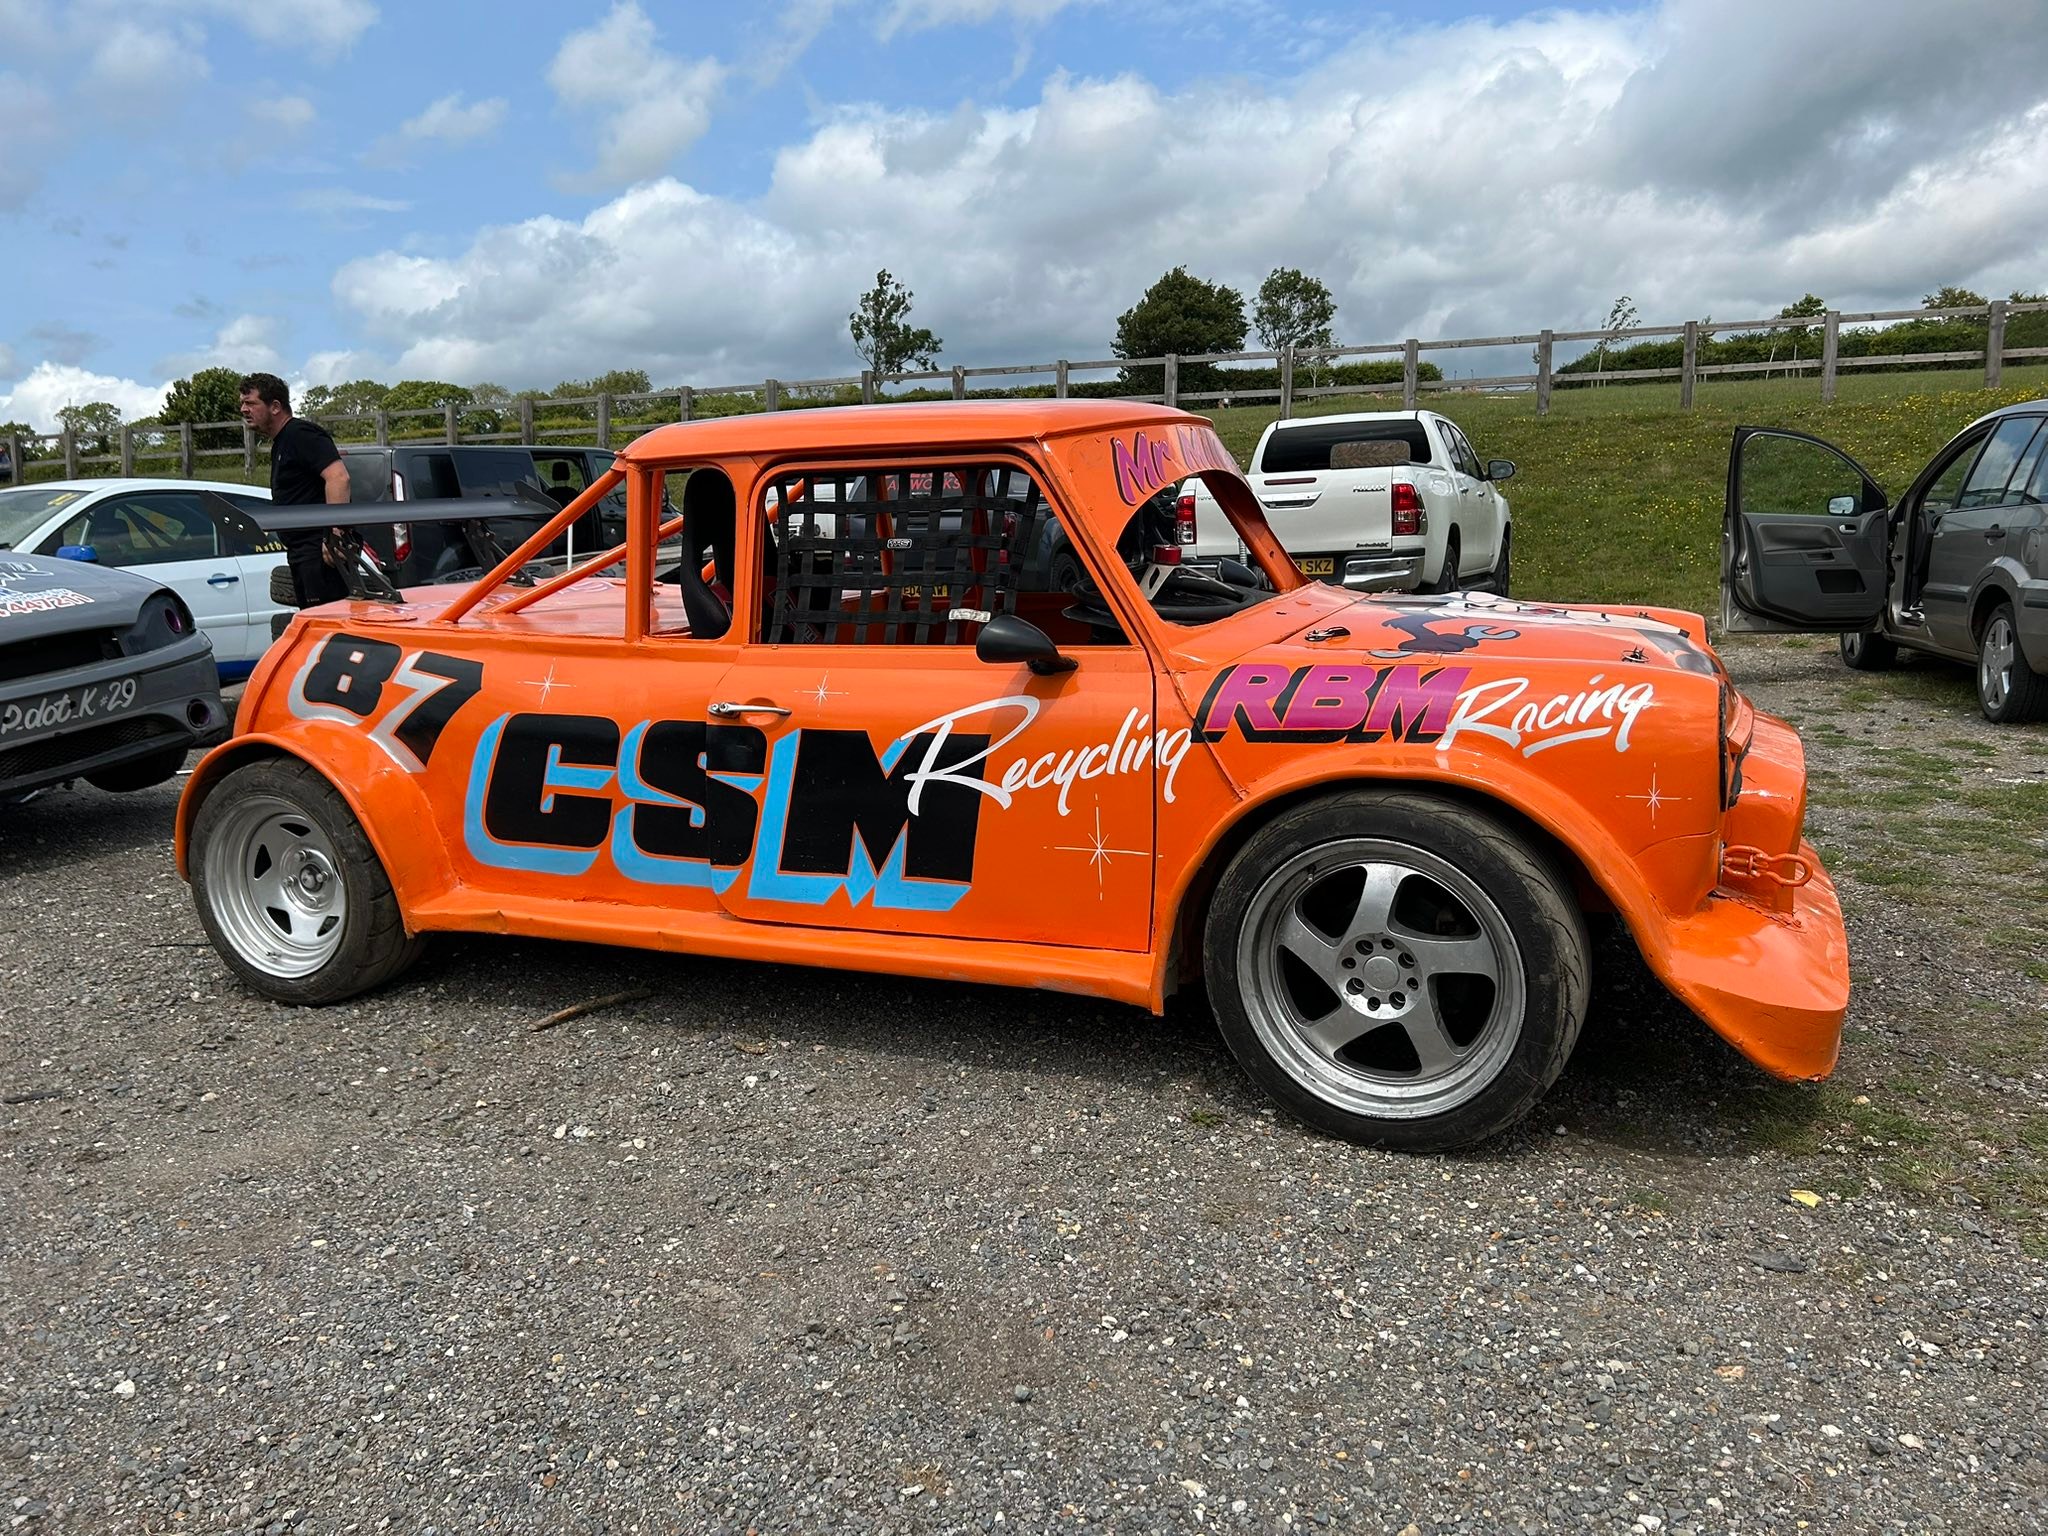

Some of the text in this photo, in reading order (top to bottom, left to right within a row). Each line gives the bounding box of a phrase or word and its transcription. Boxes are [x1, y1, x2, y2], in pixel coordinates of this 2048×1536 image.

[1110, 431, 1170, 506] Mr
[1352, 485, 1386, 493] HILUX
[1306, 560, 1331, 572] SKZ
[288, 632, 484, 773] 87
[1190, 664, 1655, 756] RBM Racing
[464, 695, 1191, 911] CSM Recycling
